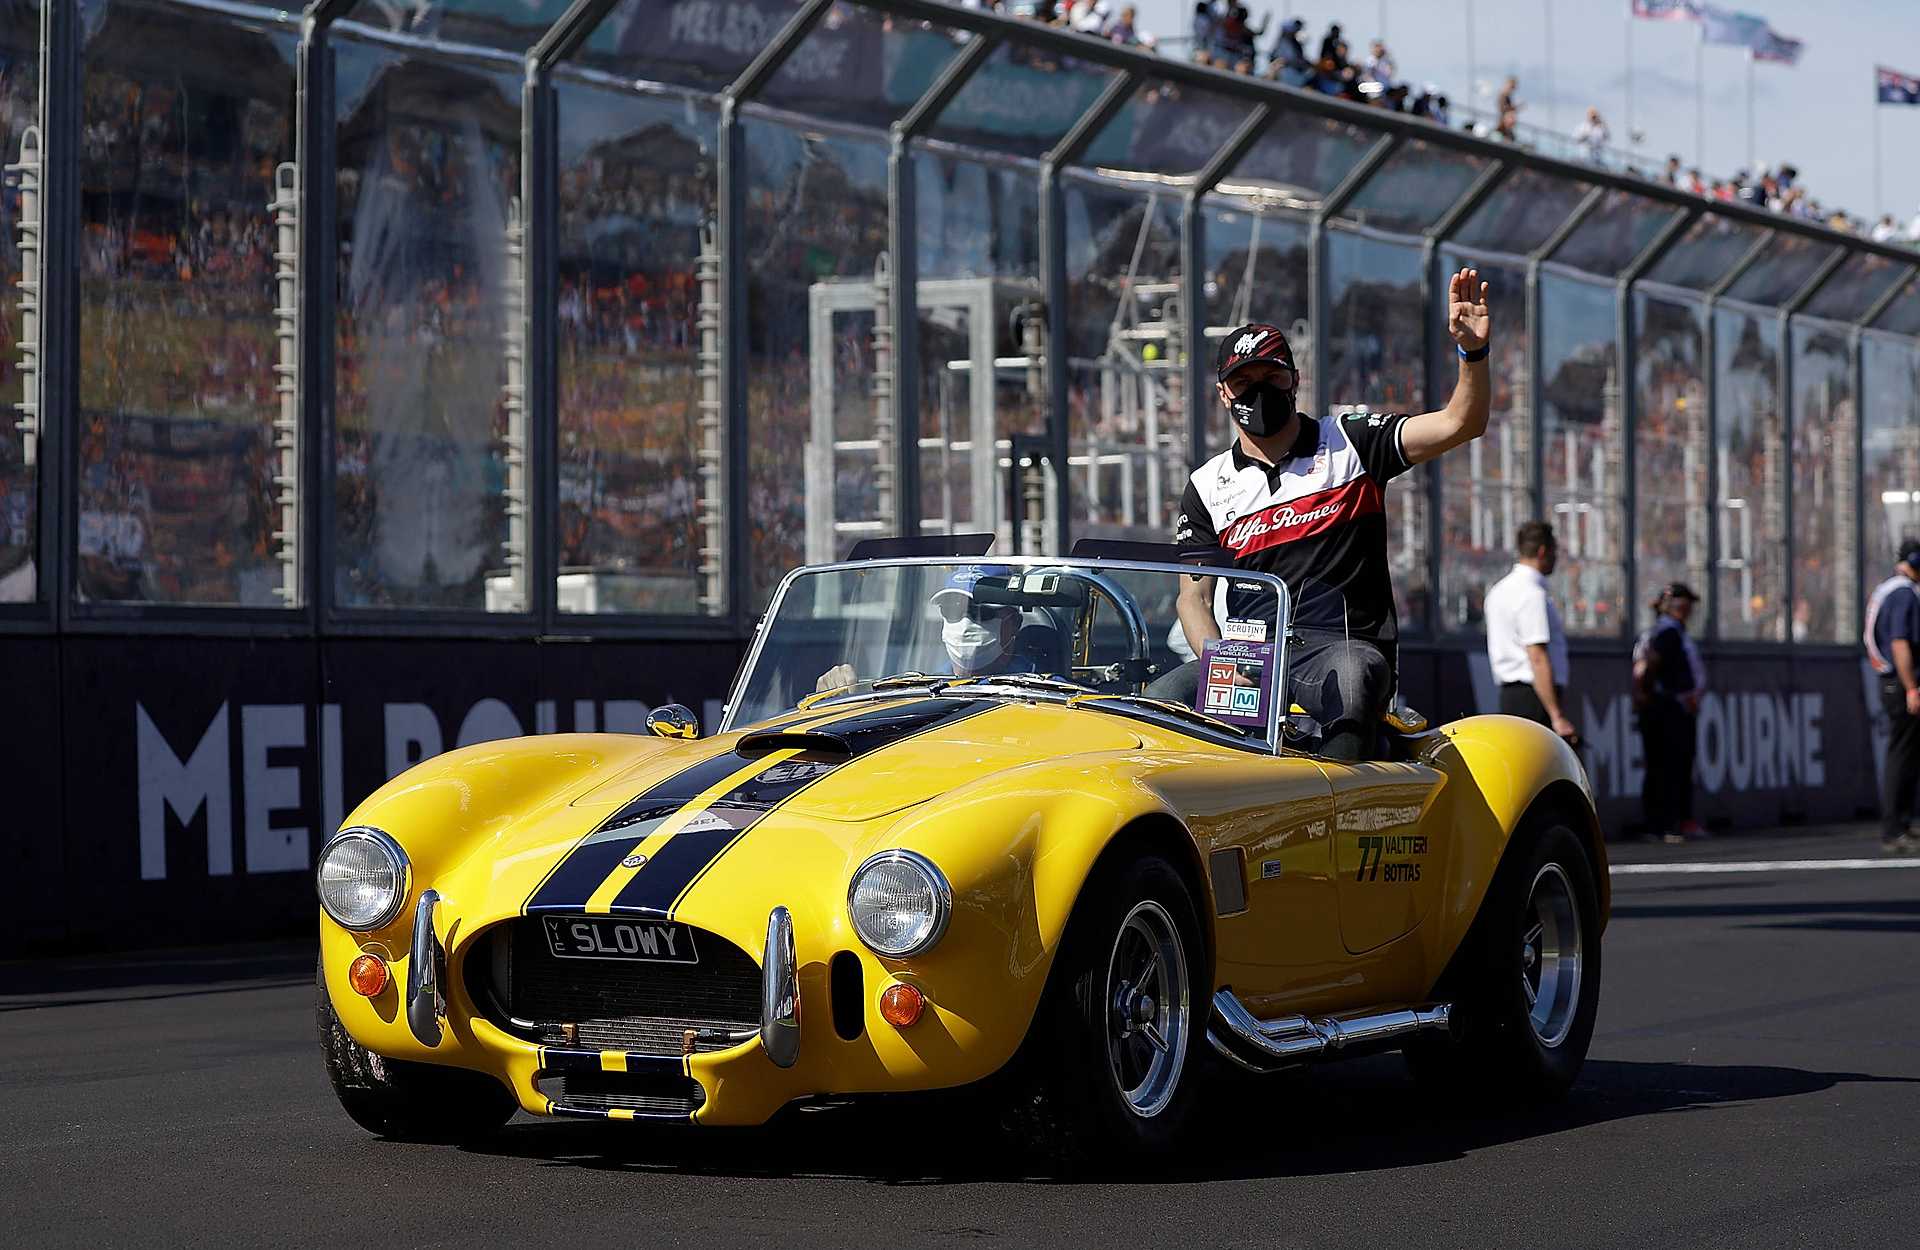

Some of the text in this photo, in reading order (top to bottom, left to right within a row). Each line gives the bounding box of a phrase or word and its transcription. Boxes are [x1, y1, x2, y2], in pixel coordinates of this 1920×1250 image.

[1227, 516, 1271, 549] Alfa
[1271, 505, 1342, 531] Romeo
[1226, 624, 1265, 634] SCRUTINY
[1212, 669, 1232, 679] SV
[1213, 690, 1227, 703] T
[1236, 692, 1255, 706] M
[1582, 692, 1826, 798] MEOURNE
[1357, 836, 1428, 882] 77 VALTTERI
[1384, 863, 1421, 883] BOTTAS
[571, 923, 677, 957] SLOWY
